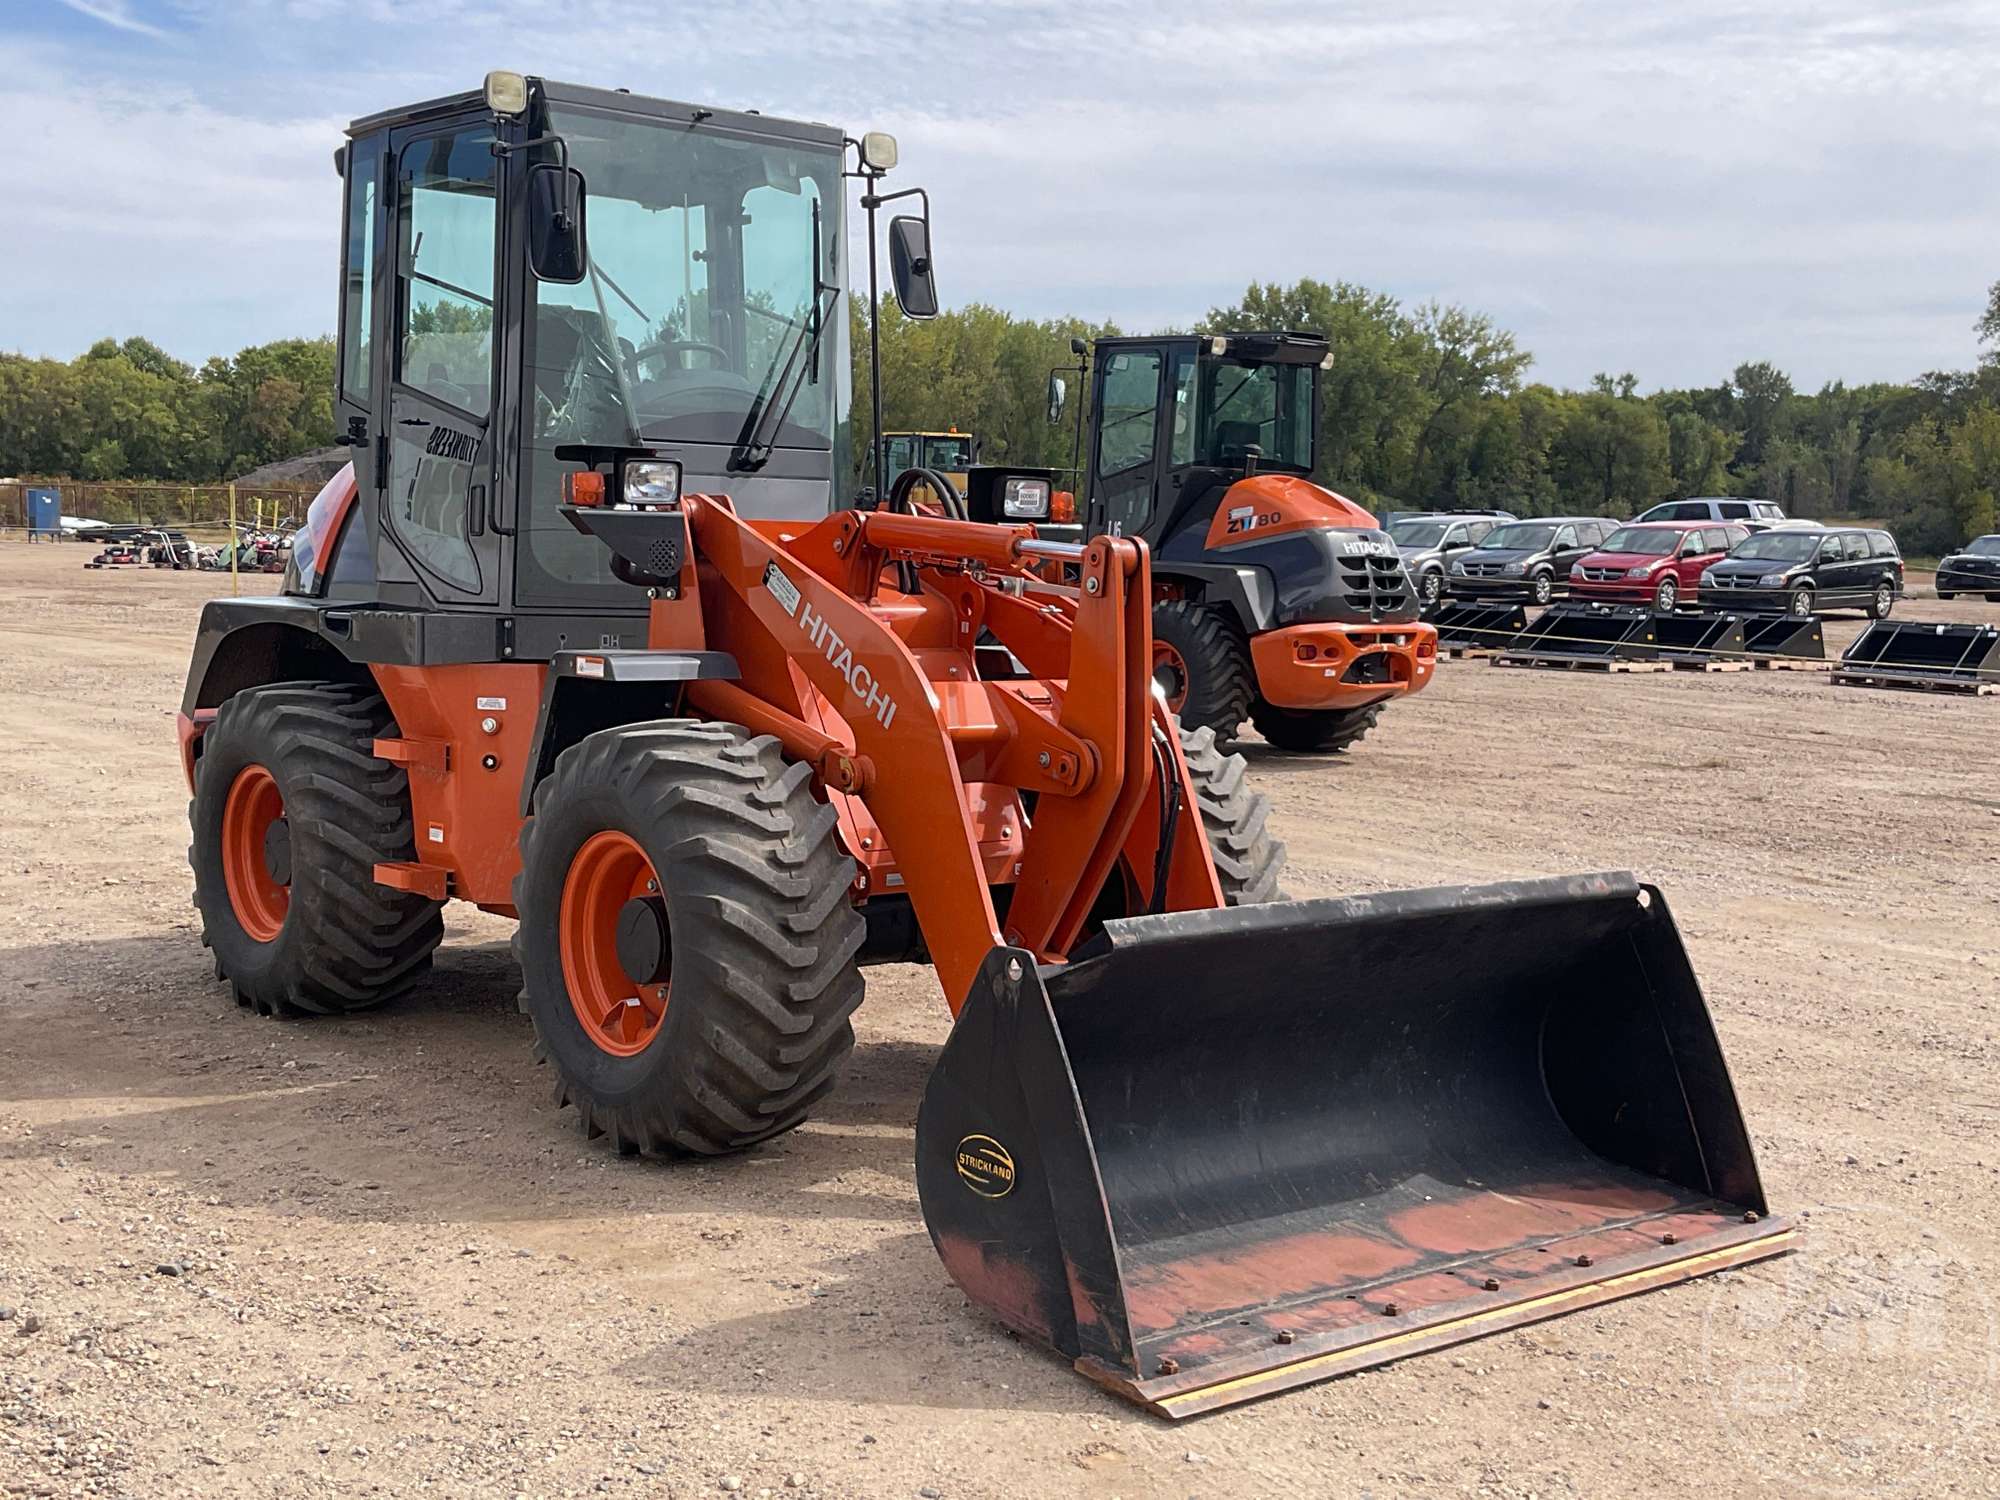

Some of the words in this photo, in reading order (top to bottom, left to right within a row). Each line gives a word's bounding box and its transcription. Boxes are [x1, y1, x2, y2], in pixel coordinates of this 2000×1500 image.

[1343, 541, 1392, 555] HITACHI
[799, 602, 898, 730] HITACHI
[959, 1152, 1012, 1181] STRICKLAND
